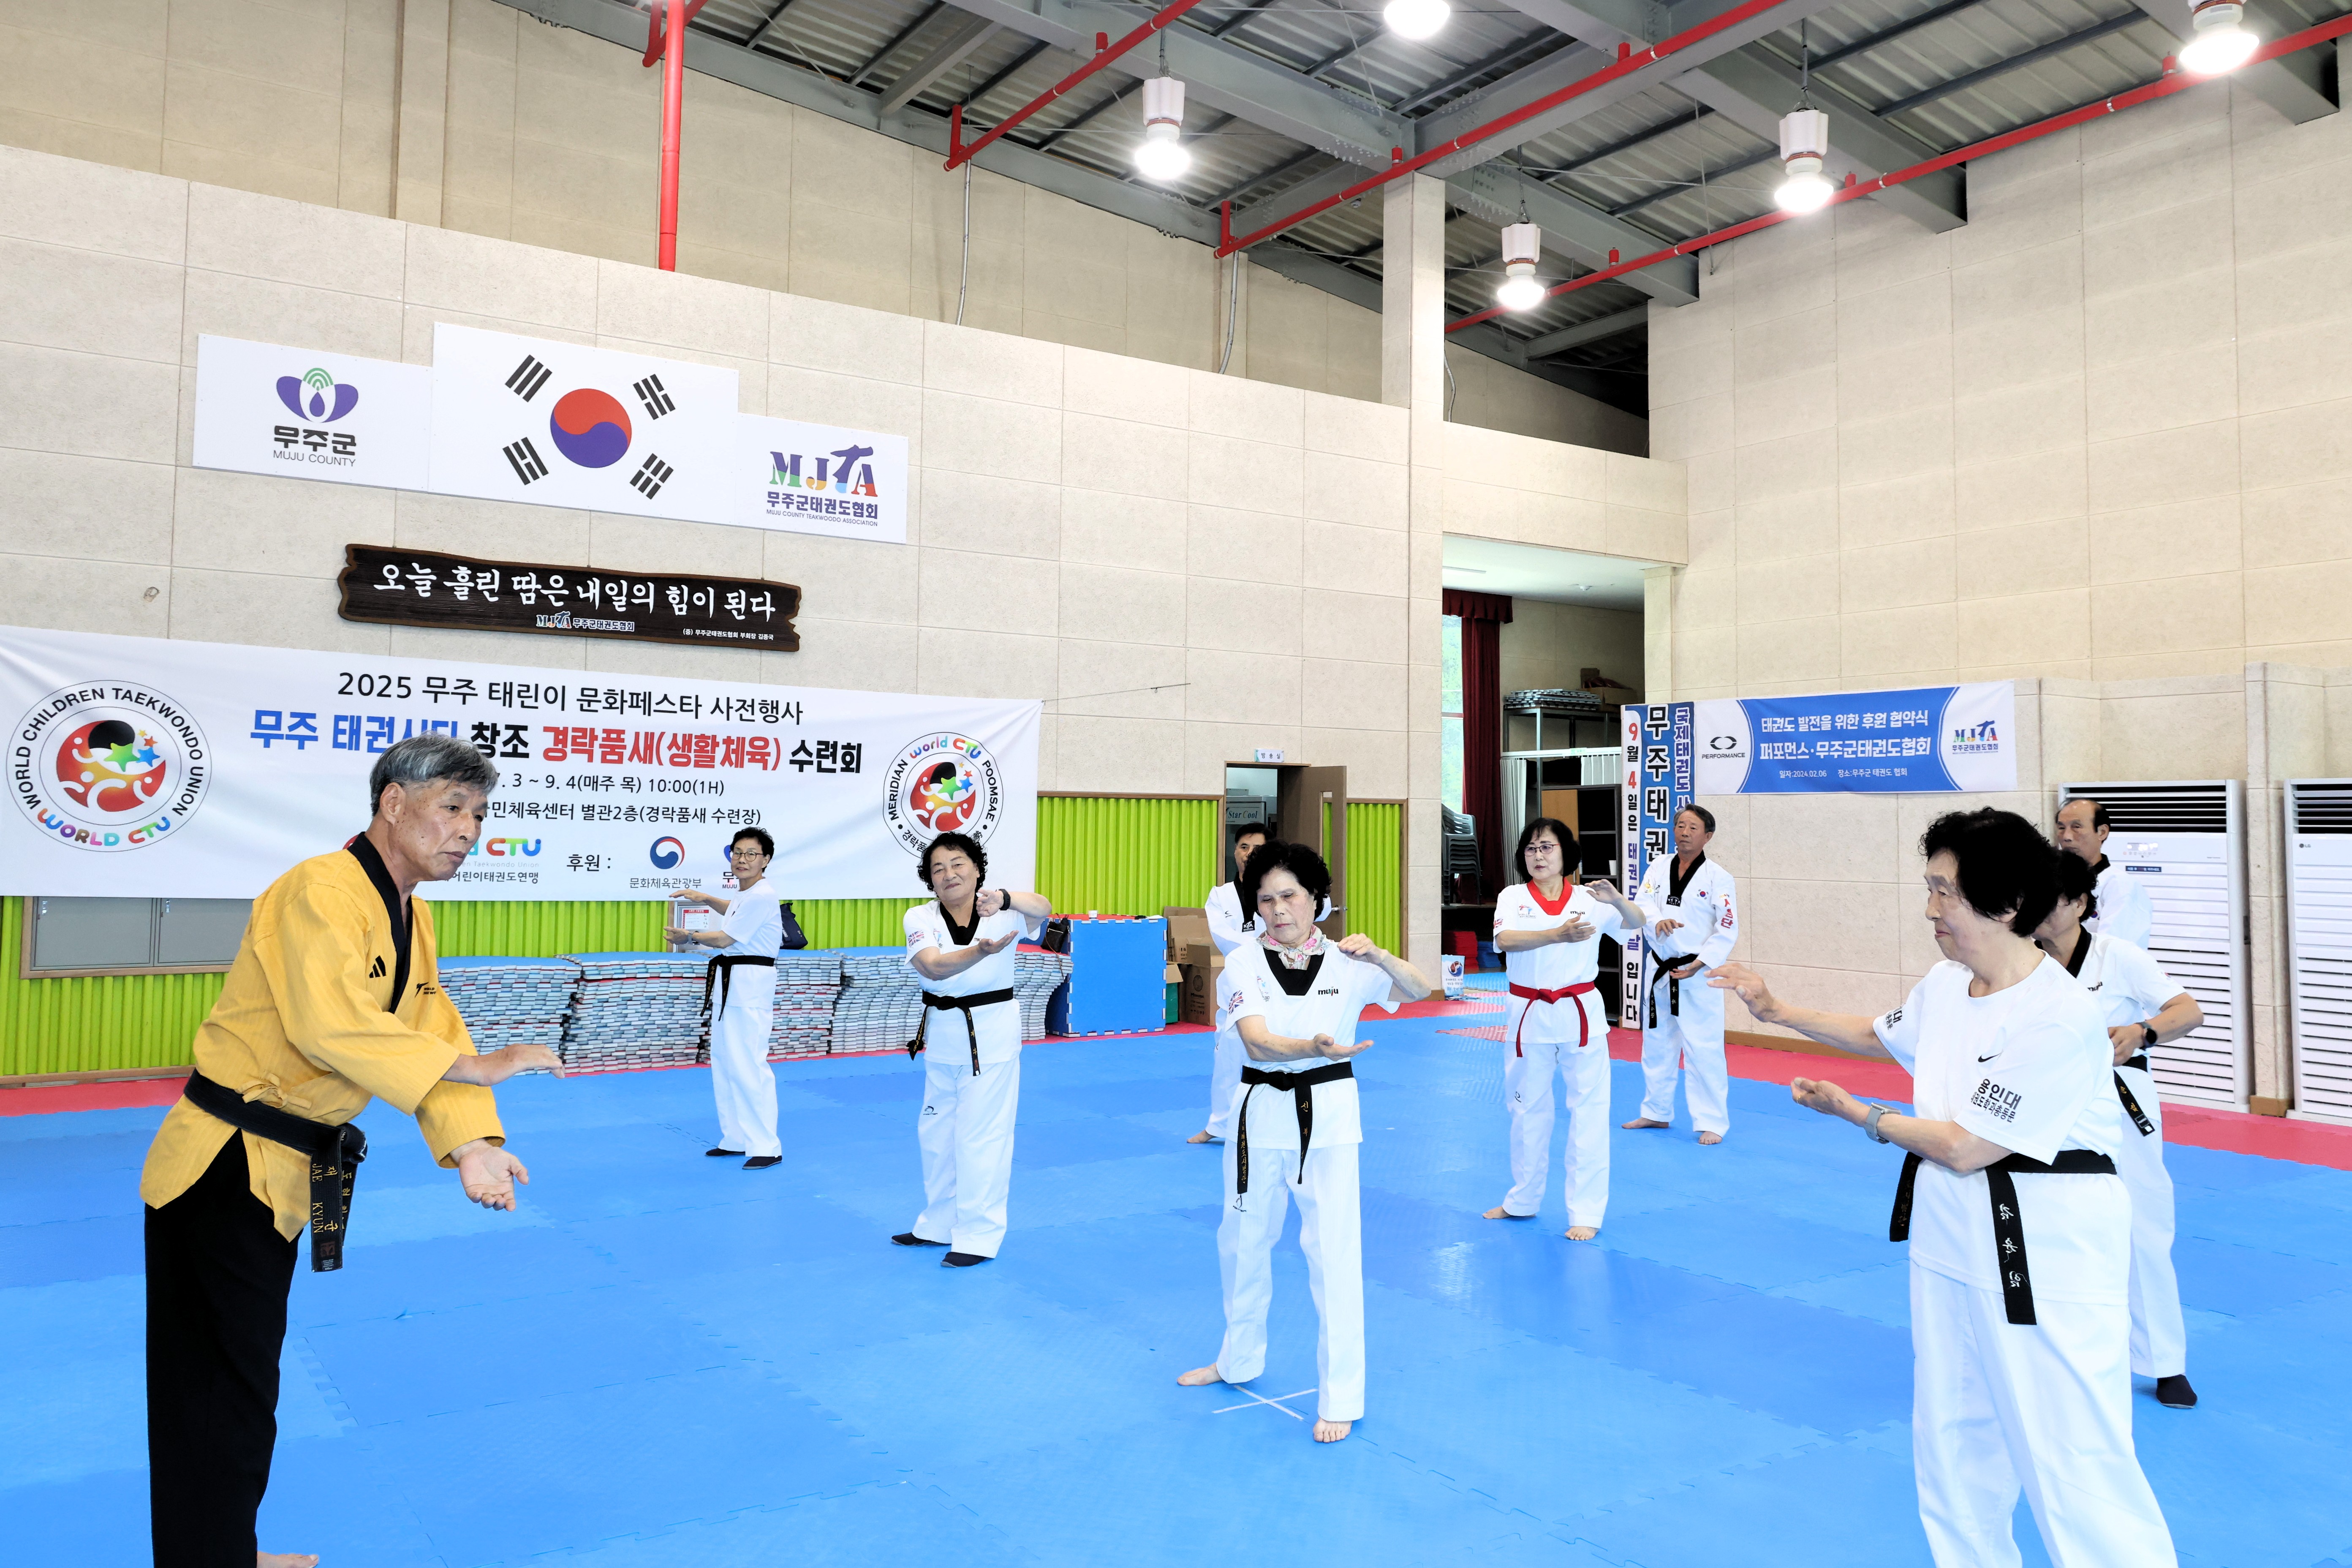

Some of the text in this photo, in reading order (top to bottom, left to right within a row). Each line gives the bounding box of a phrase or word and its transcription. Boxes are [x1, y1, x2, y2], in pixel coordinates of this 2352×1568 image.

[274, 425, 357, 456] 무주군
[273, 449, 357, 467] MUJU COUNTY
[767, 491, 878, 520] 무주군태권도협회
[782, 510, 805, 519] COUNTY
[842, 518, 878, 527] ASSOCIATION
[374, 562, 775, 623] 오늘 흘린 땀은 내일의 힘이 된다
[573, 618, 634, 631] 무주군태권도협회
[695, 629, 738, 638] 무주군태권도협회
[740, 631, 756, 640] 부회장
[338, 672, 803, 725] 2025 무주 태린이 문화페스타 사전행사
[1762, 710, 1928, 733] 태권도 발전을 위한 후원 협약식
[15, 688, 204, 816] WORLD CHILDREN TAEKWONDO UNION
[250, 709, 318, 750] 무주
[470, 721, 530, 759] 창조
[542, 726, 781, 771] 경락품새(생활체육)
[789, 739, 862, 773] 수련회
[953, 738, 982, 759] CTU
[1675, 708, 1689, 791] 국제태권도
[1952, 743, 1999, 751] 무주군태권도협회
[1779, 767, 1907, 778] 일자:2024.02.06 장소:무주군 태권도 협회
[566, 775, 615, 792] 4(매주
[620, 776, 642, 793] 목)
[649, 780, 725, 796] 10:00(1H)
[888, 759, 908, 821] MERIDIAN
[982, 760, 998, 822] POOMSAE
[581, 804, 707, 823] 별관2층(경락품새
[711, 807, 761, 826] 수련장)
[1228, 810, 1258, 818] Star Cool
[128, 816, 171, 844] CTU
[486, 838, 541, 856] CTU
[567, 854, 600, 871] 후원
[630, 878, 702, 889] 문화체육관광부
[1626, 962, 1639, 1022] 입니다
[1978, 1079, 2022, 1110] 용인대
[312, 1163, 323, 1234] JAE KYUN
